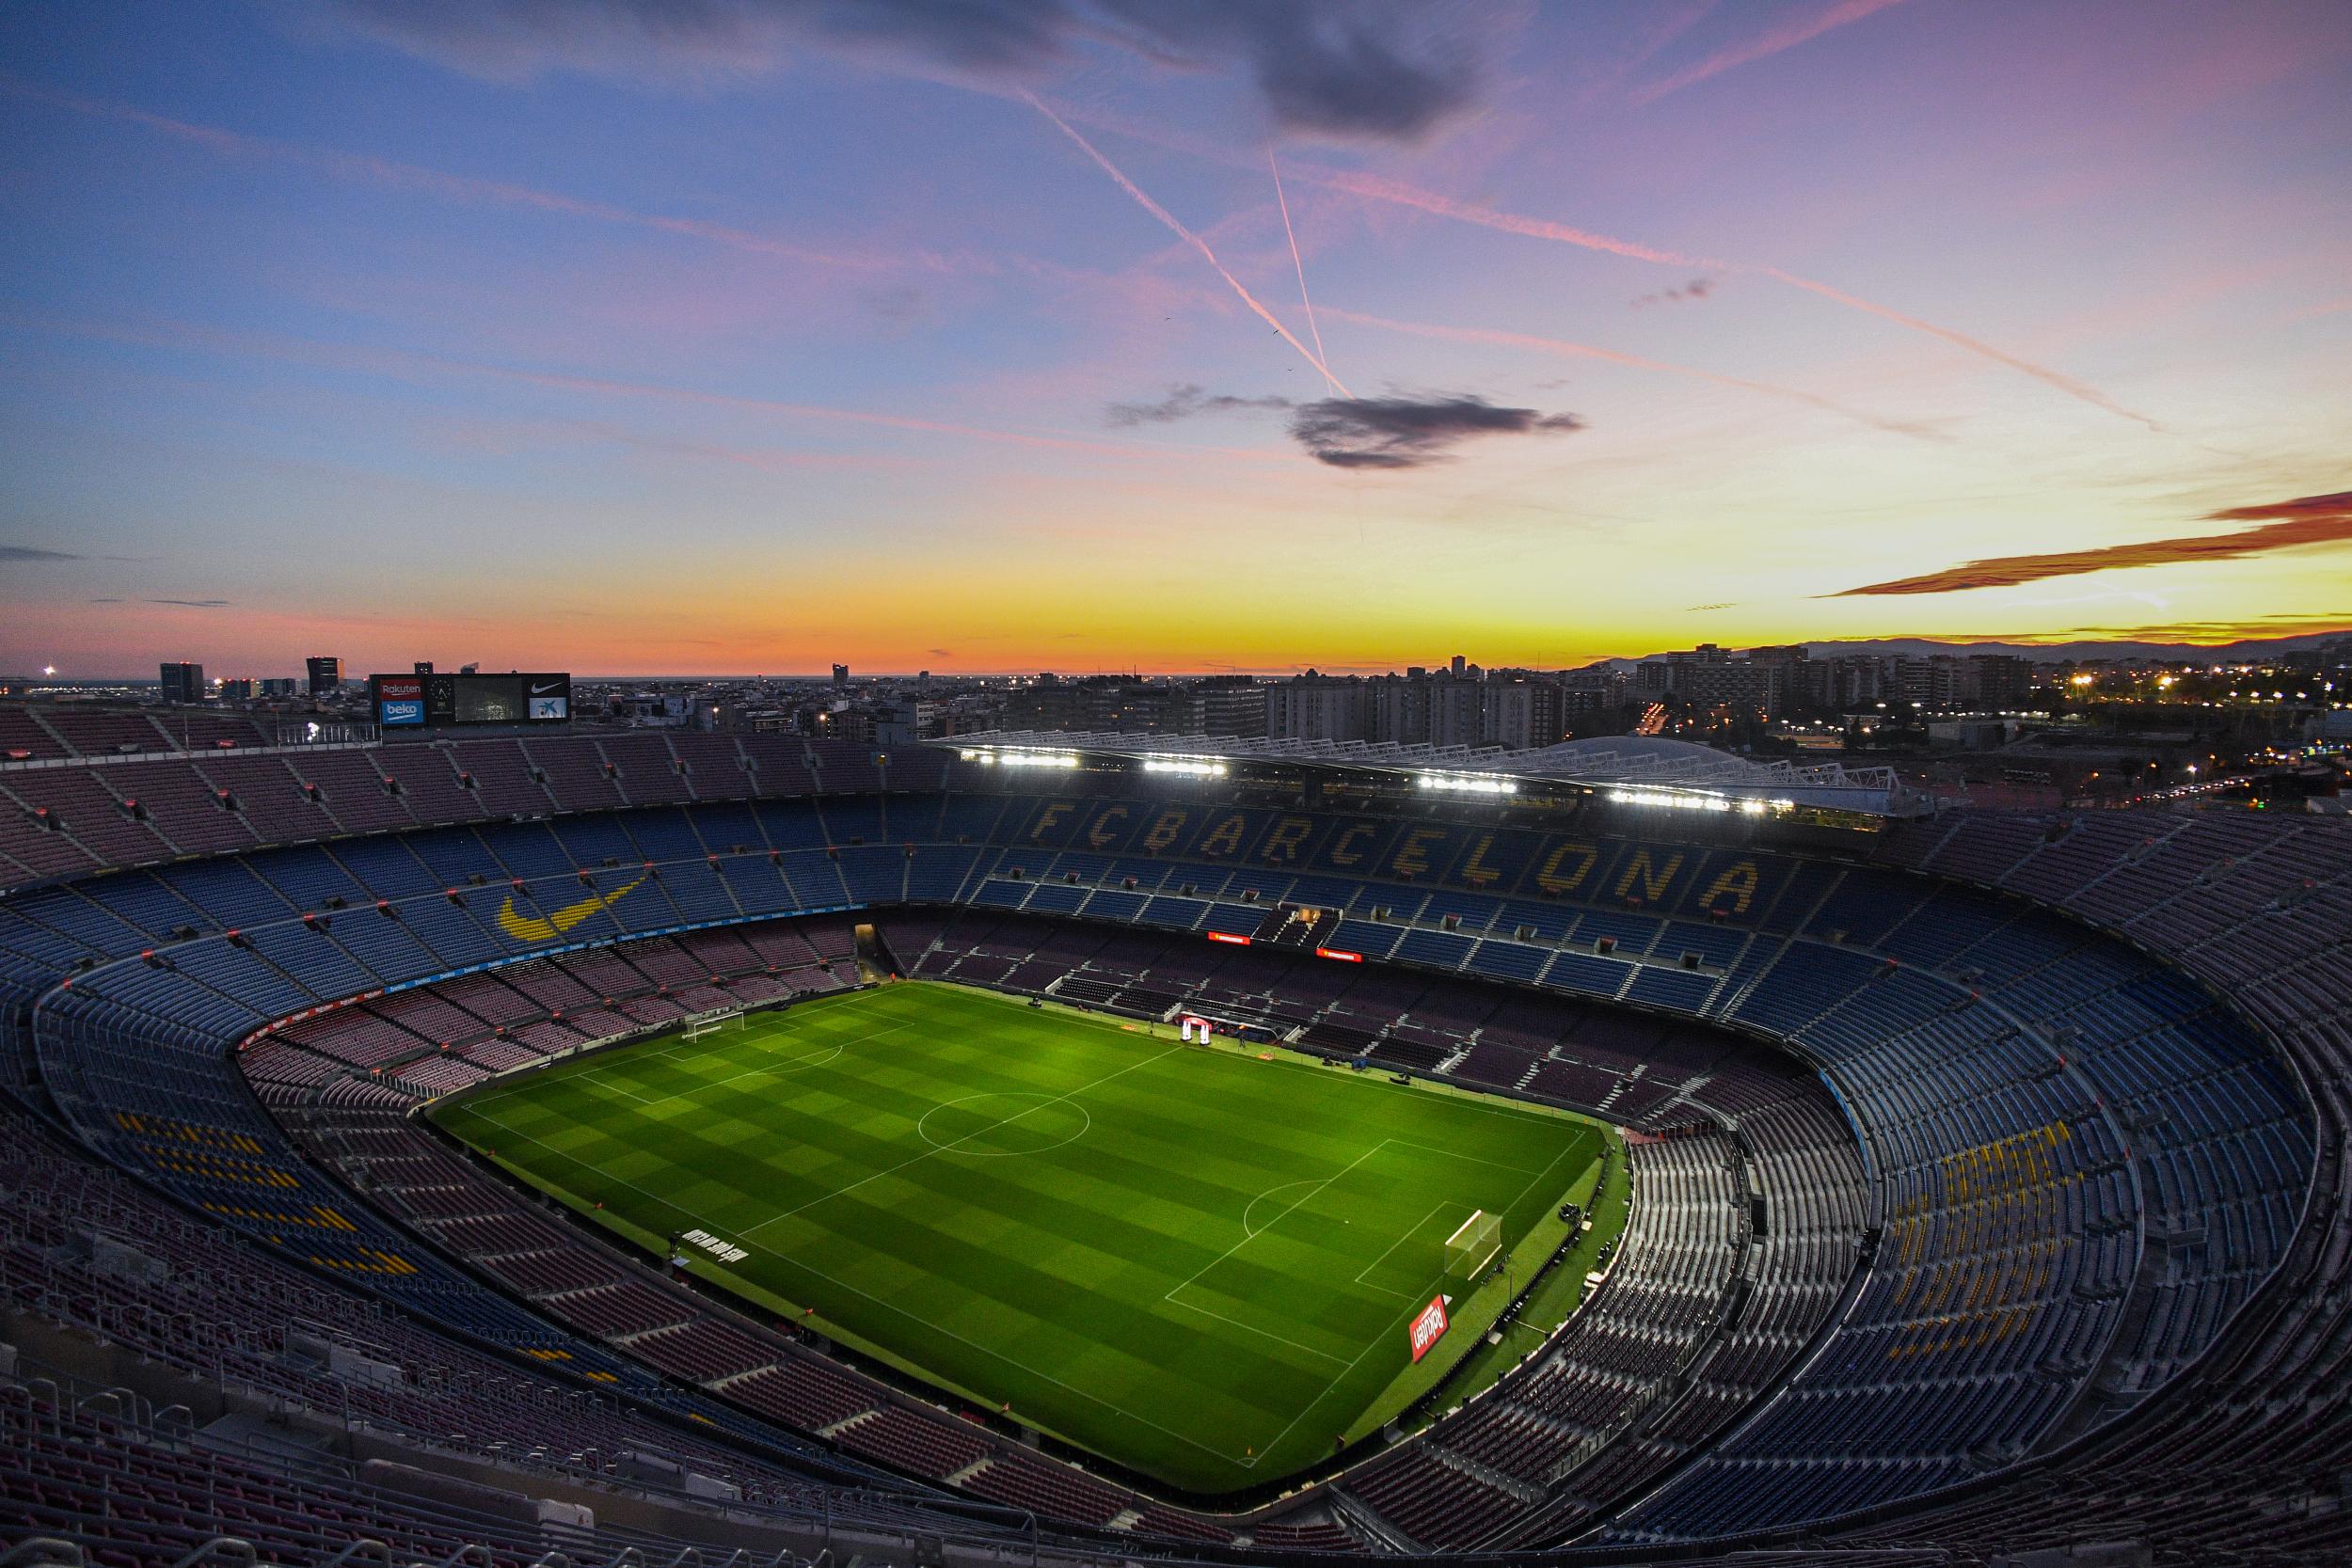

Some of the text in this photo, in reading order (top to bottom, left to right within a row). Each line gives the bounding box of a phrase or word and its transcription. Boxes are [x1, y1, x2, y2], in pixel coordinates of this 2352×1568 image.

[383, 685, 421, 694] Rakuten
[387, 705, 417, 715] beko
[1031, 804, 1760, 912] FC BARCELONA
[1413, 1305, 1444, 1350] Rakuten
